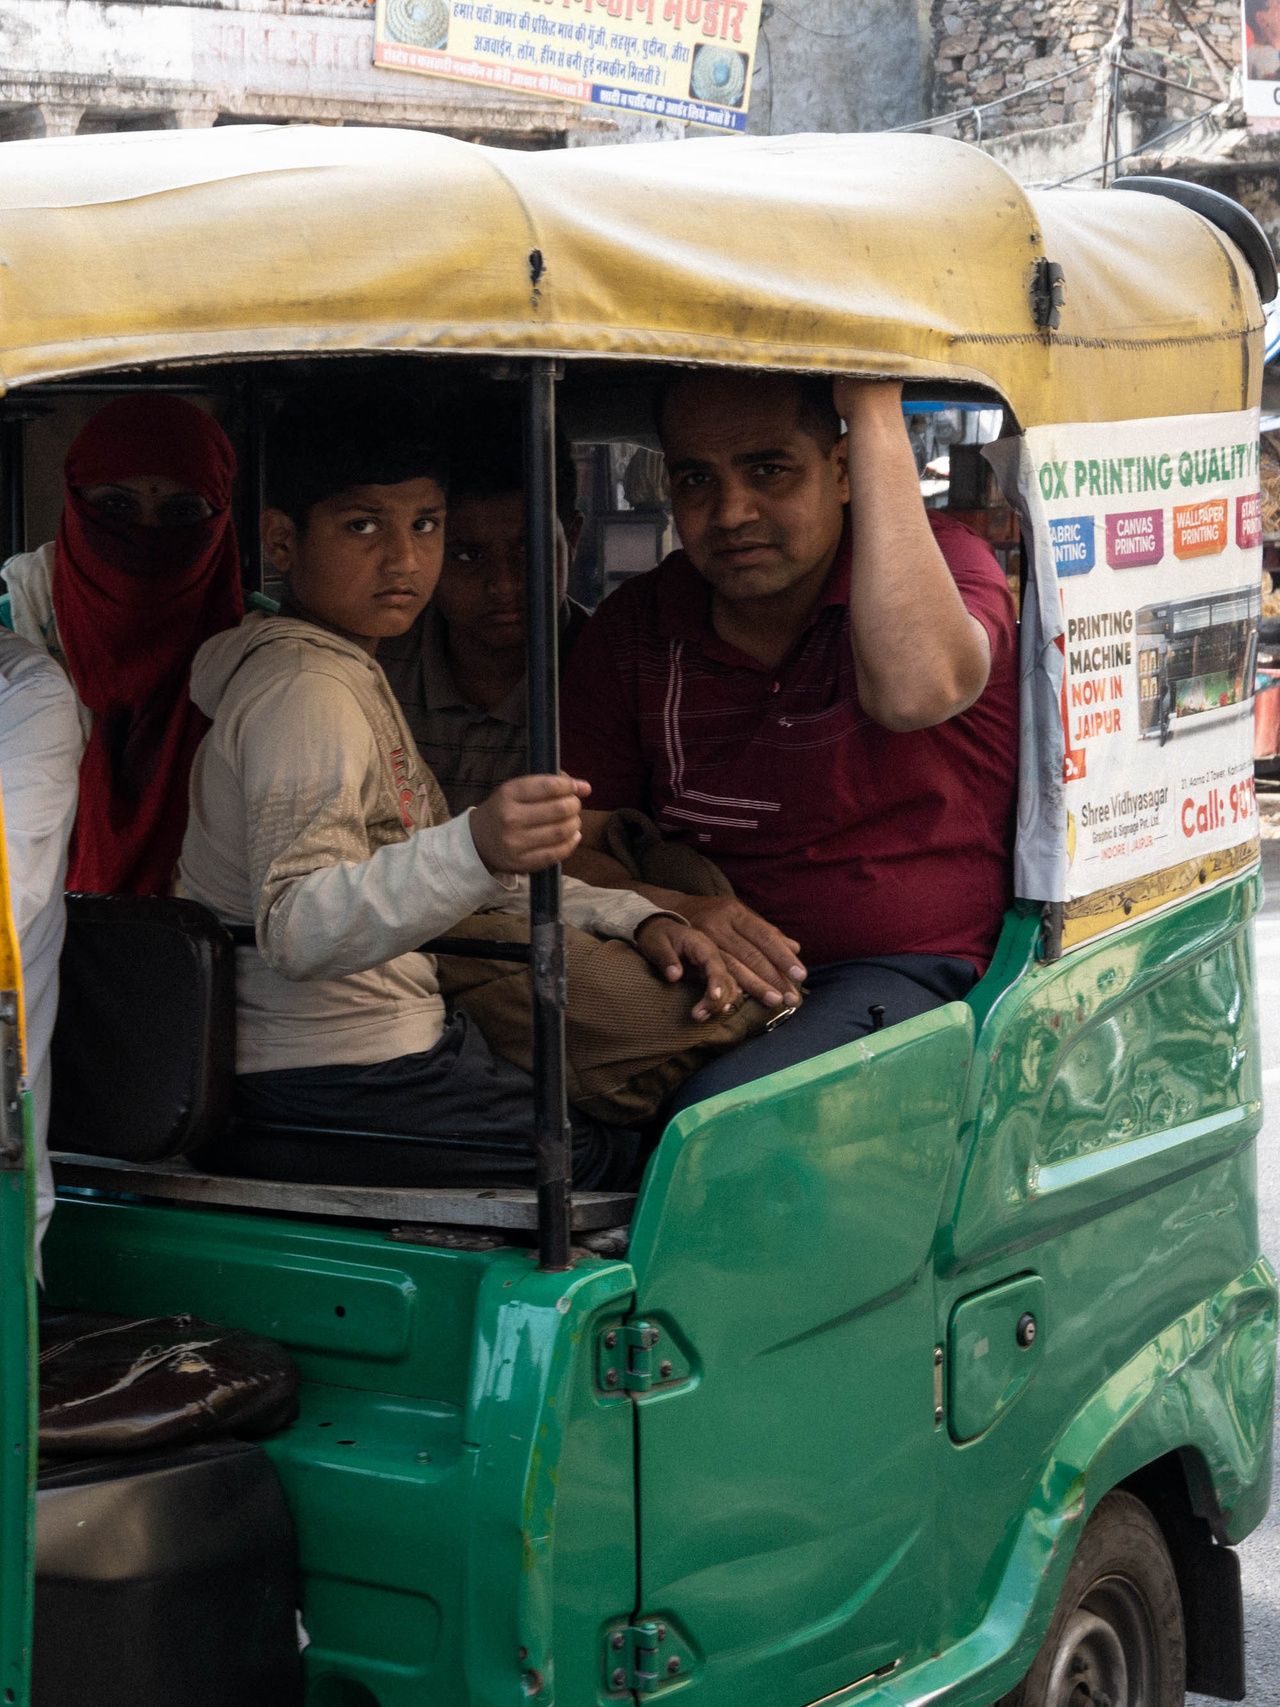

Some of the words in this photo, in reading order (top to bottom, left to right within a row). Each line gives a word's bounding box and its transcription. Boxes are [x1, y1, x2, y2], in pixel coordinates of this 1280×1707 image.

[1074, 453, 1172, 498] PRINTING
[1178, 441, 1254, 487] QUALITY
[1048, 523, 1081, 543] ABRIC
[1116, 516, 1153, 536] CANVAS
[1176, 506, 1224, 528] WALLPAPER
[1115, 535, 1156, 556] PRINTING
[1181, 524, 1219, 546] PRINTING
[1068, 609, 1133, 642] PRINTING
[1070, 641, 1132, 675] MACHINE
[1072, 678, 1108, 708] NOW
[1110, 674, 1123, 698] IN
[1074, 708, 1121, 741] JAIPUR
[1081, 802, 1110, 828] Shree
[1110, 786, 1169, 820] Vidhyasagar
[1181, 788, 1225, 838] Call:
